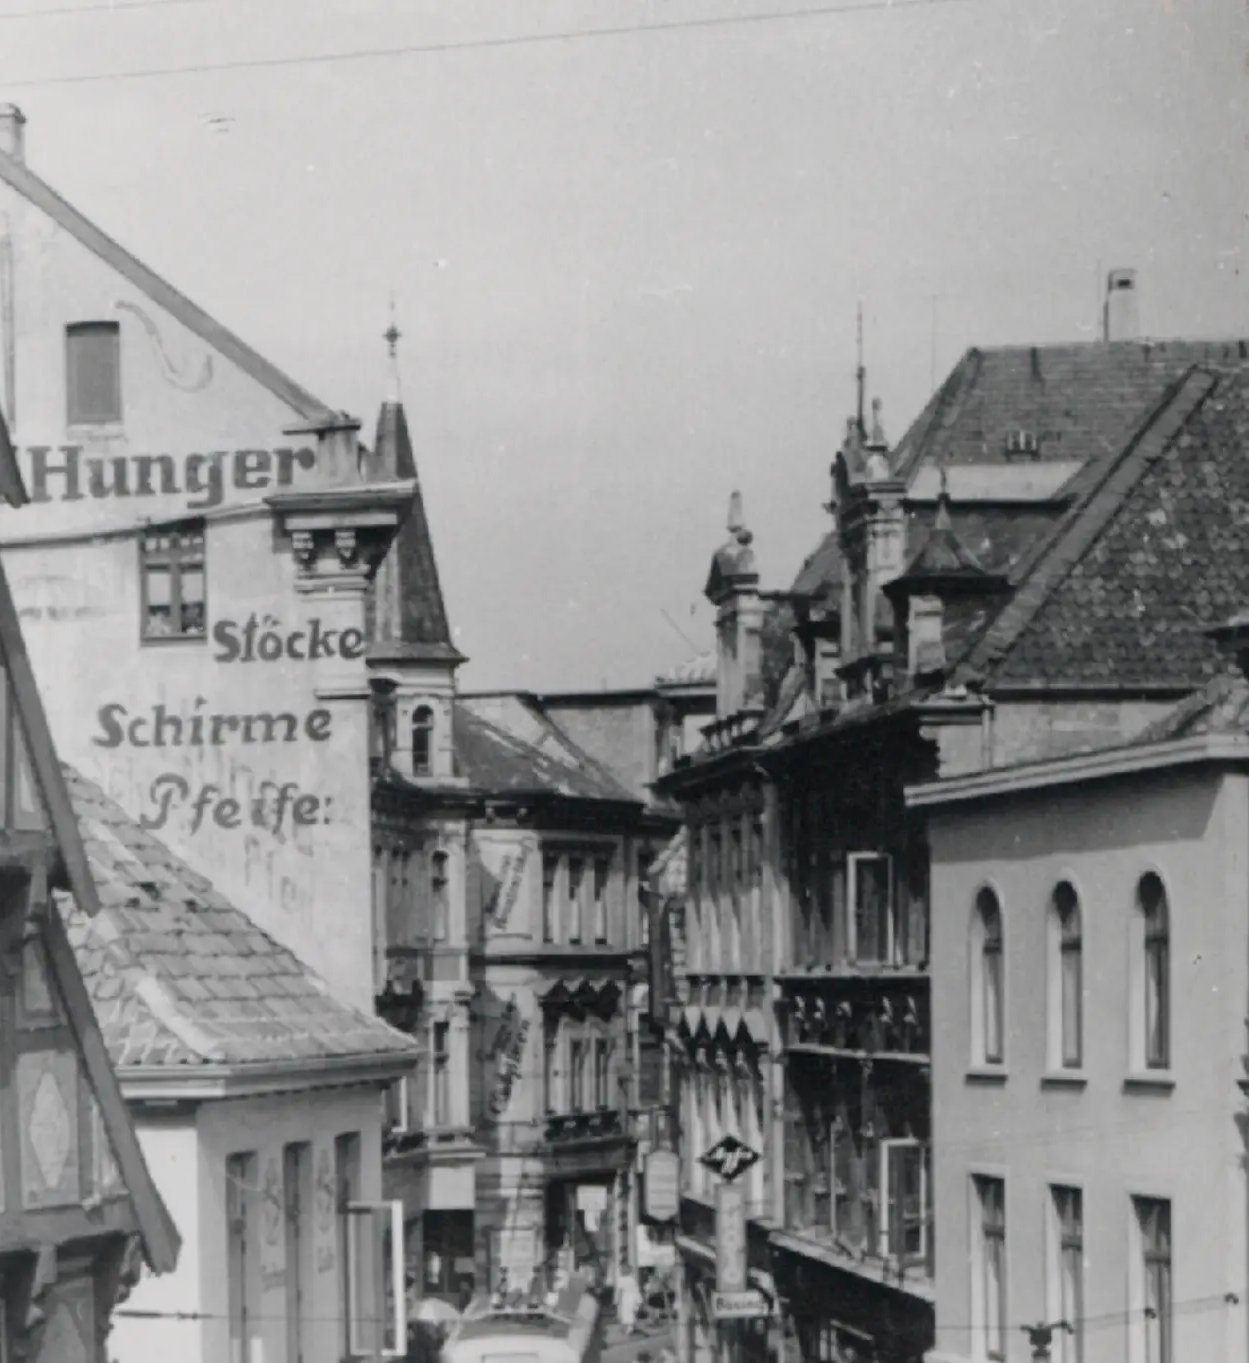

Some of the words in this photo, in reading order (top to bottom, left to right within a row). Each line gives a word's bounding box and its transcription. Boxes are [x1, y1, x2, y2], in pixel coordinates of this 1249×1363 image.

[26, 445, 316, 505] Hunger
[213, 612, 365, 663] Stöcke
[91, 697, 332, 748] Schirme
